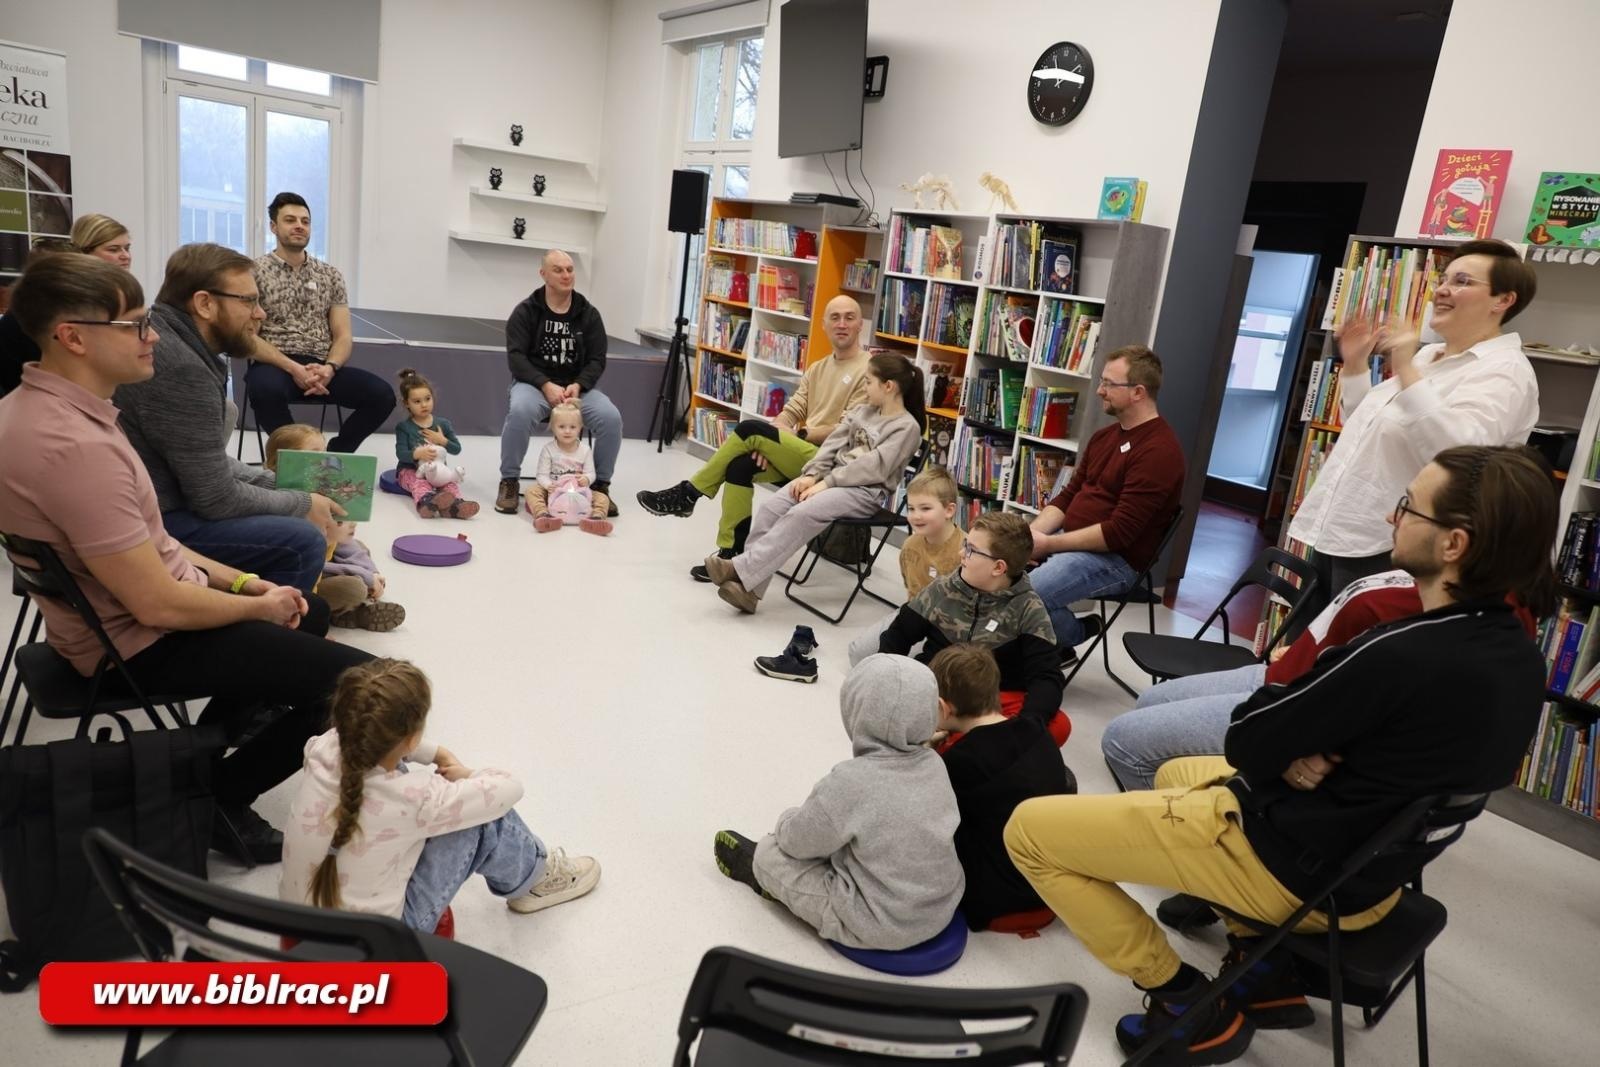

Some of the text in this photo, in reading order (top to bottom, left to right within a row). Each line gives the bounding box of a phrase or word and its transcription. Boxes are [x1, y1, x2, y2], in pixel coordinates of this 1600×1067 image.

[1448, 152, 1482, 164] Dzieci
[1552, 194, 1600, 204] RYSOWANIE
[1549, 210, 1597, 218] MINECRAFT
[1332, 270, 1345, 310] HOBBY
[545, 320, 570, 335] UPE
[1002, 471, 1010, 500] NAUKA
